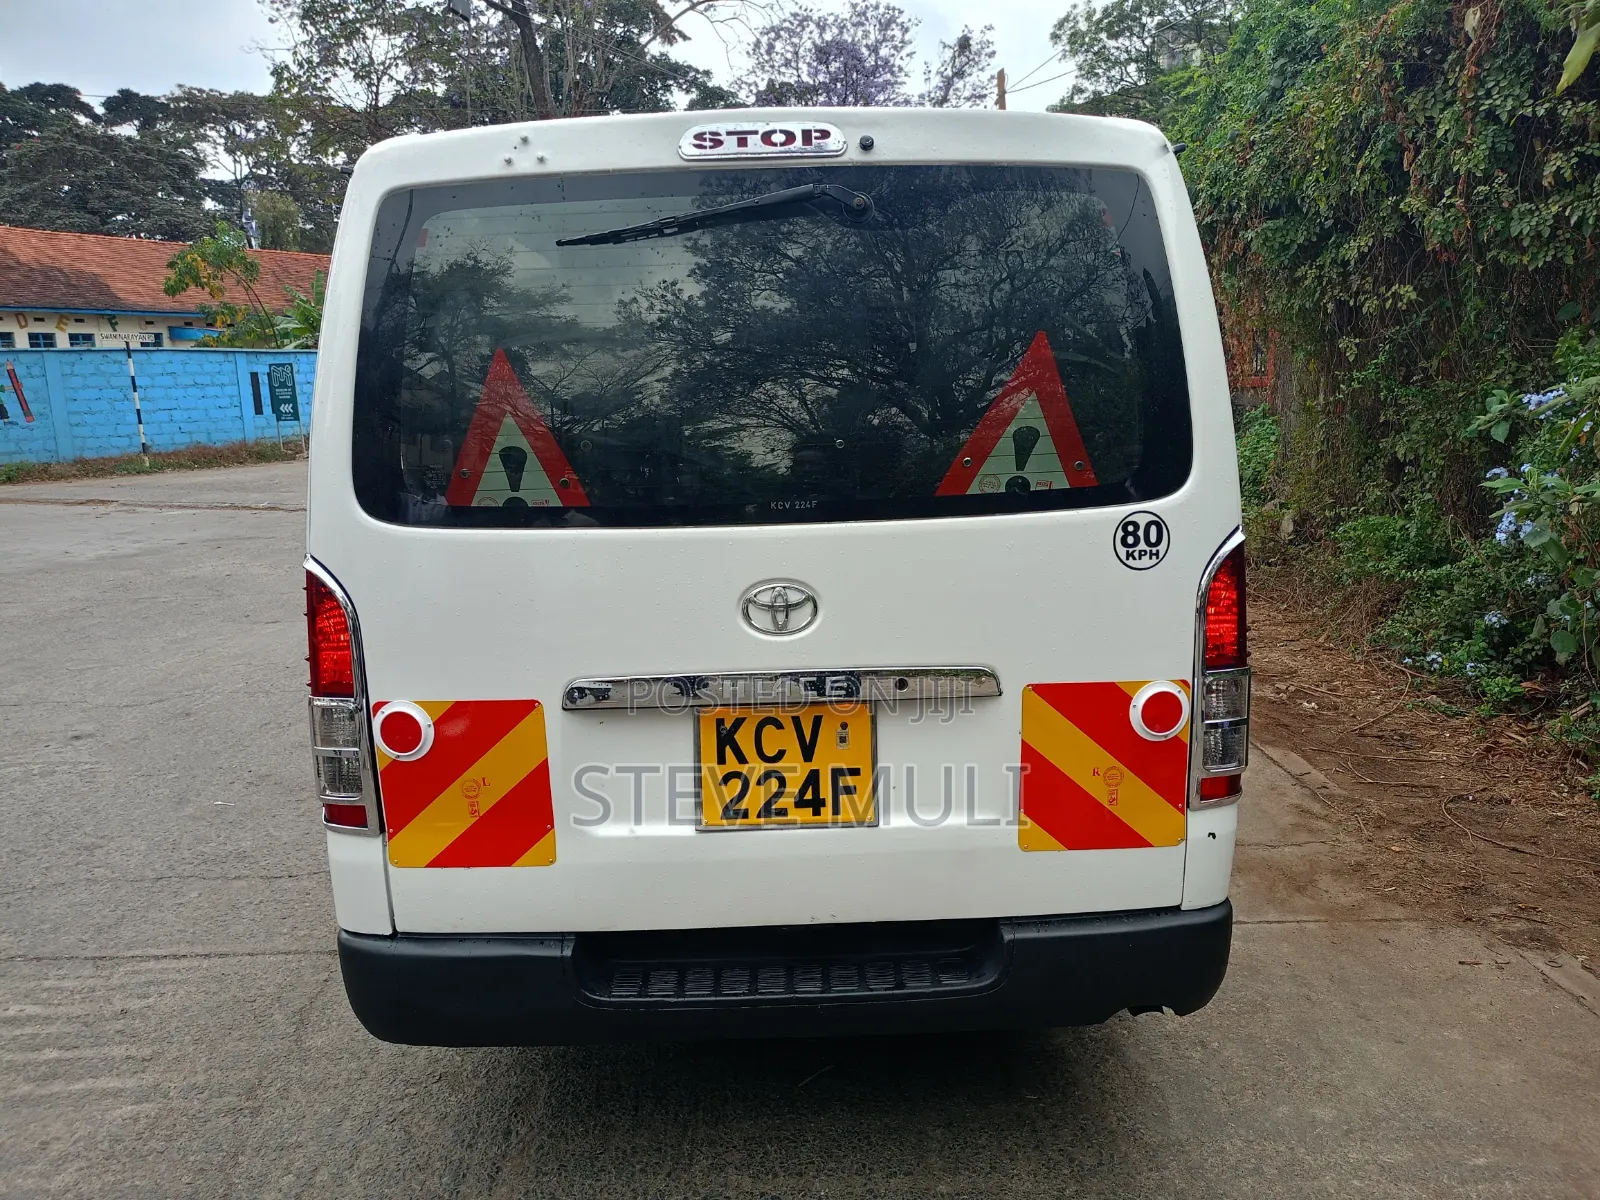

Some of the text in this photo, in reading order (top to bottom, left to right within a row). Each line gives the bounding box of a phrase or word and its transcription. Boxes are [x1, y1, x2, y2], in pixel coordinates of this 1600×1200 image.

[692, 129, 831, 149] STOP
[770, 500, 818, 510] KCV 224F
[1120, 520, 1163, 549] 80
[1126, 549, 1160, 561] KPH
[715, 715, 824, 766] KCV
[718, 767, 862, 820] 224F
